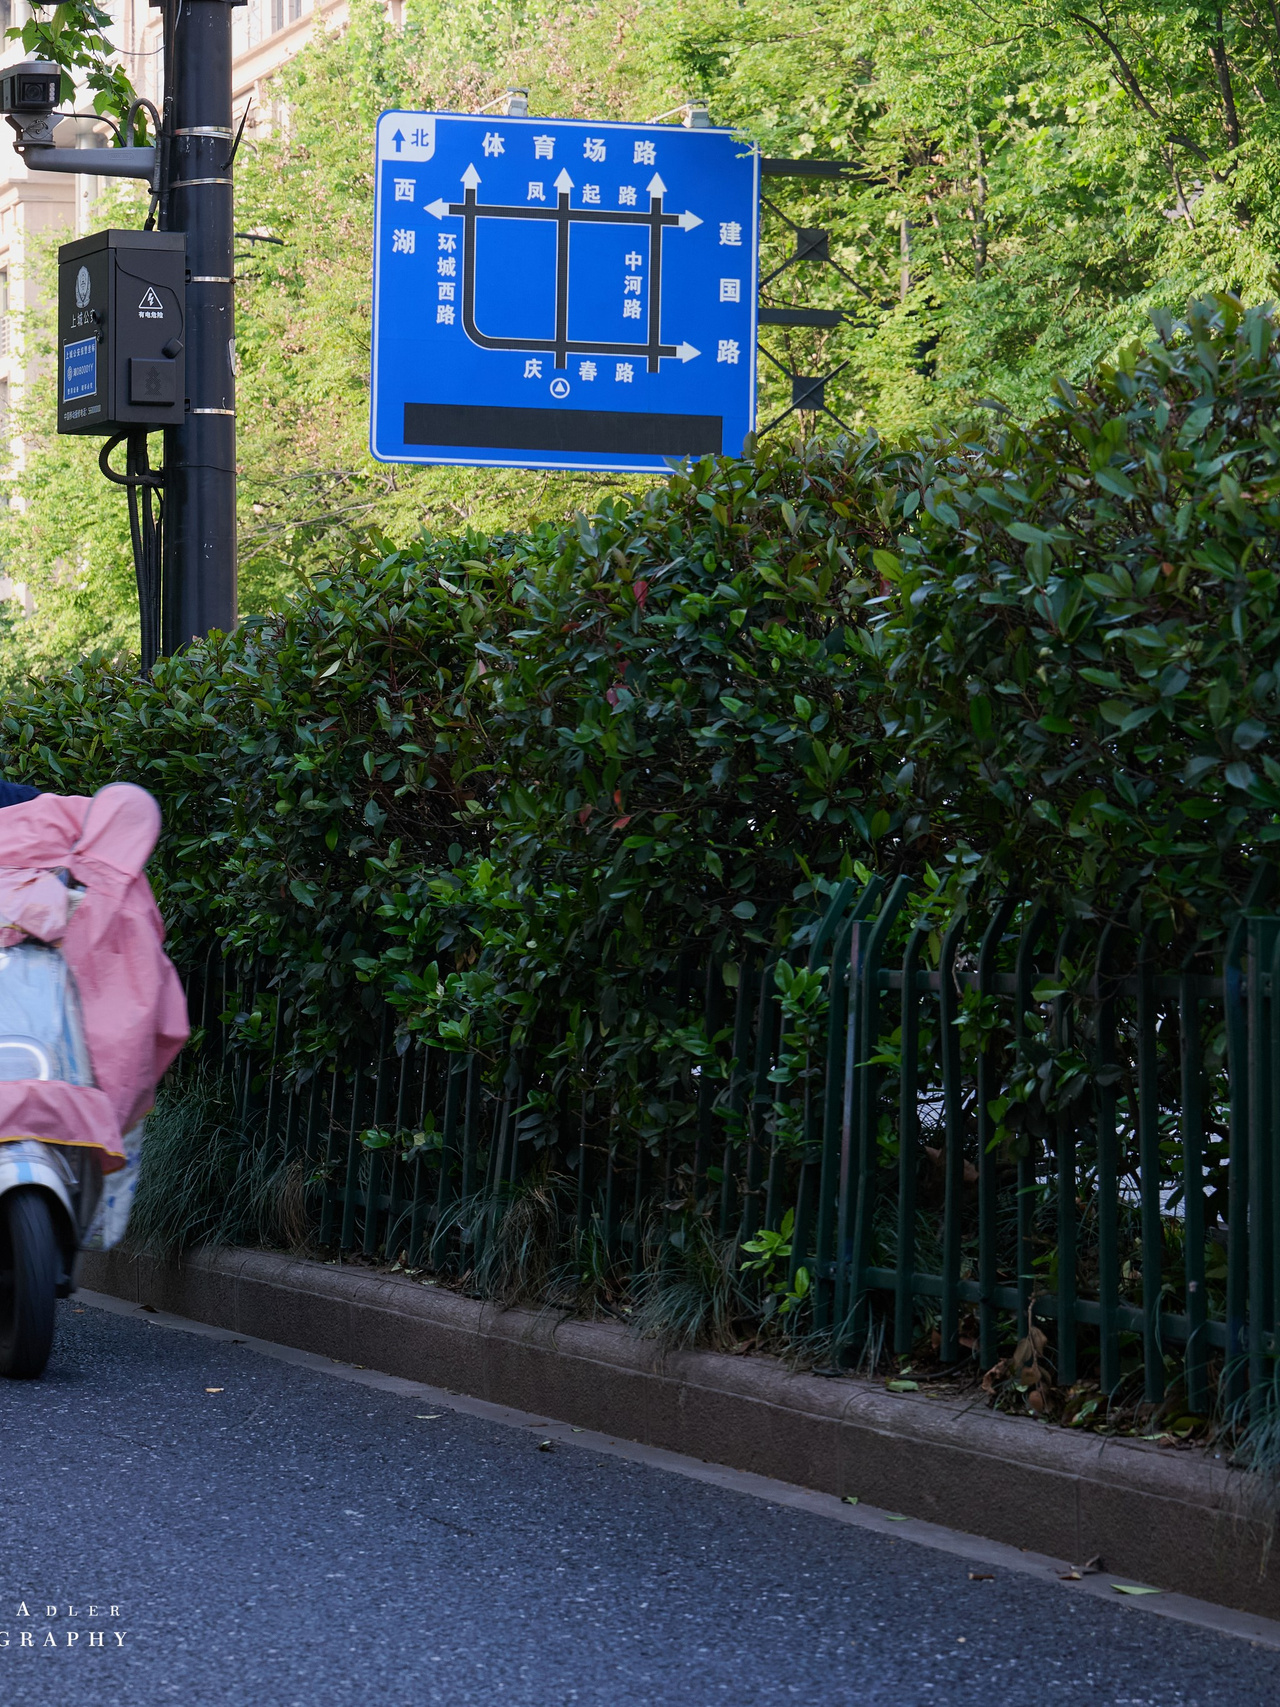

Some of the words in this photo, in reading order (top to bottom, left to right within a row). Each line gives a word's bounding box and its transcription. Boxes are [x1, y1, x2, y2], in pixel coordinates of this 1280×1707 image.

[410, 128, 430, 147] 北
[481, 131, 658, 166] 体育场路
[392, 178, 416, 254] 西湖
[526, 181, 638, 206] 凤起路
[436, 232, 457, 325] 环城西路
[622, 250, 642, 320] 中河路
[717, 221, 743, 364] 建国路
[523, 358, 634, 383] 庆春路
